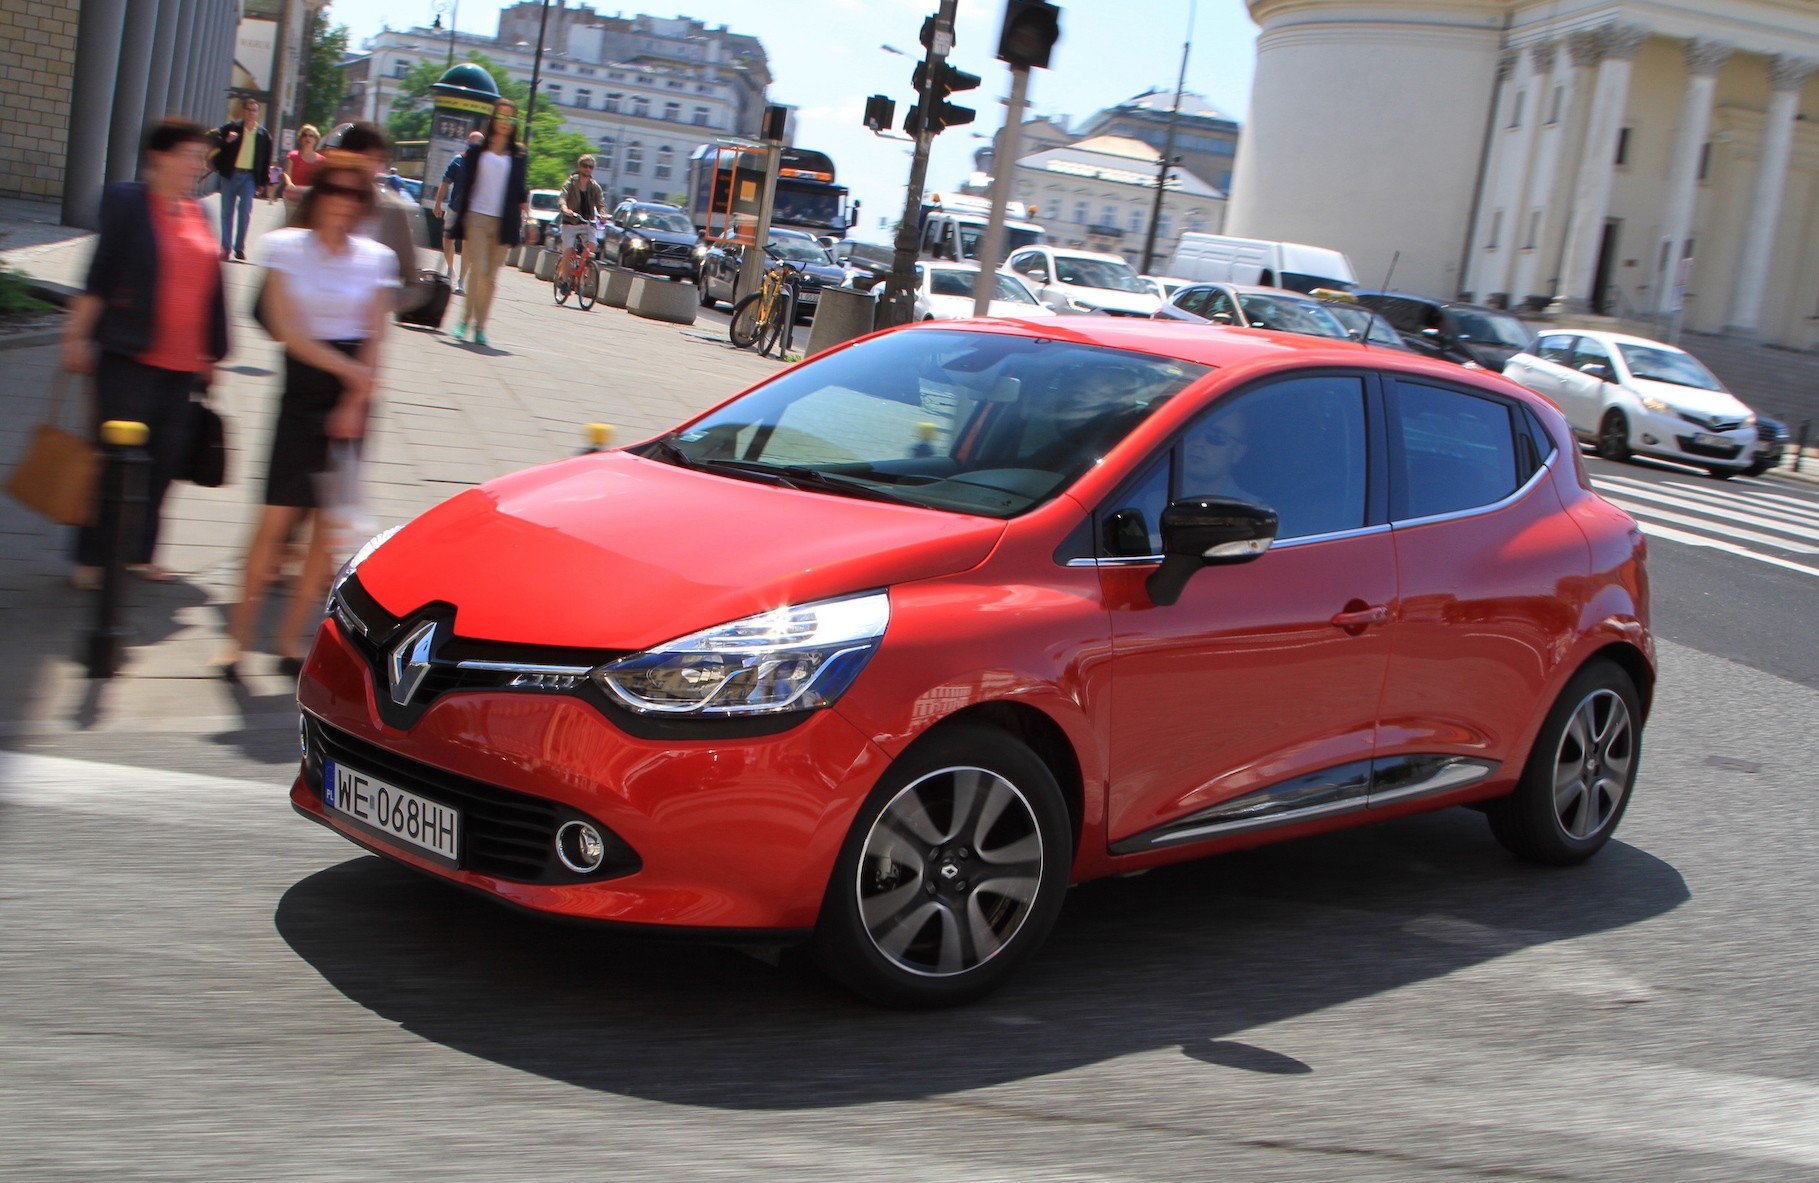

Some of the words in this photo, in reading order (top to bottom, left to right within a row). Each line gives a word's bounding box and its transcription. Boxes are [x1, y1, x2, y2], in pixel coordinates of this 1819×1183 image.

[326, 788, 334, 801] PL
[338, 769, 369, 820] WE
[377, 787, 454, 854] 068HH
